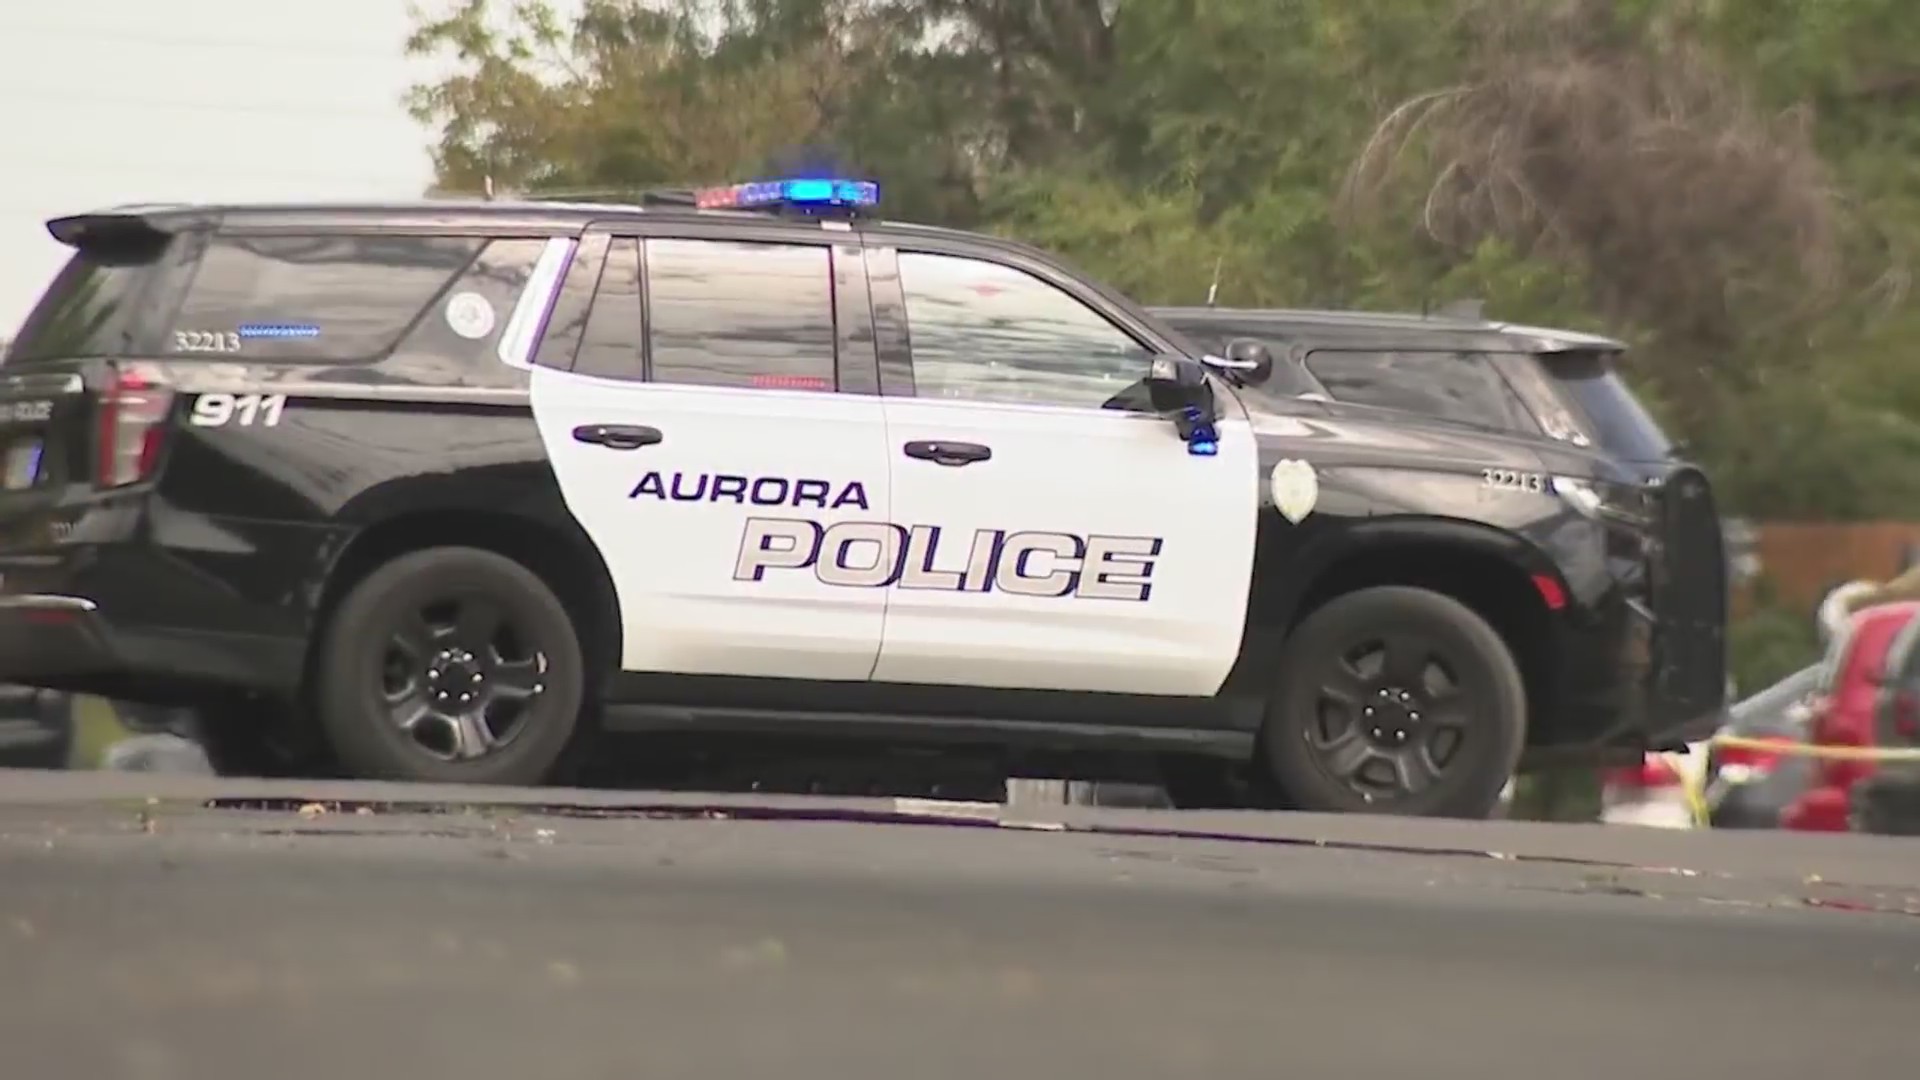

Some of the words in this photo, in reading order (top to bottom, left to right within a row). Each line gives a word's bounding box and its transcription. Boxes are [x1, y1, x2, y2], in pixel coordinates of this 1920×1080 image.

[175, 330, 241, 352] 32213
[190, 394, 286, 427] 911
[629, 471, 869, 510] AURORA
[1481, 468, 1541, 494] 32213
[733, 517, 1163, 601] POLICE
